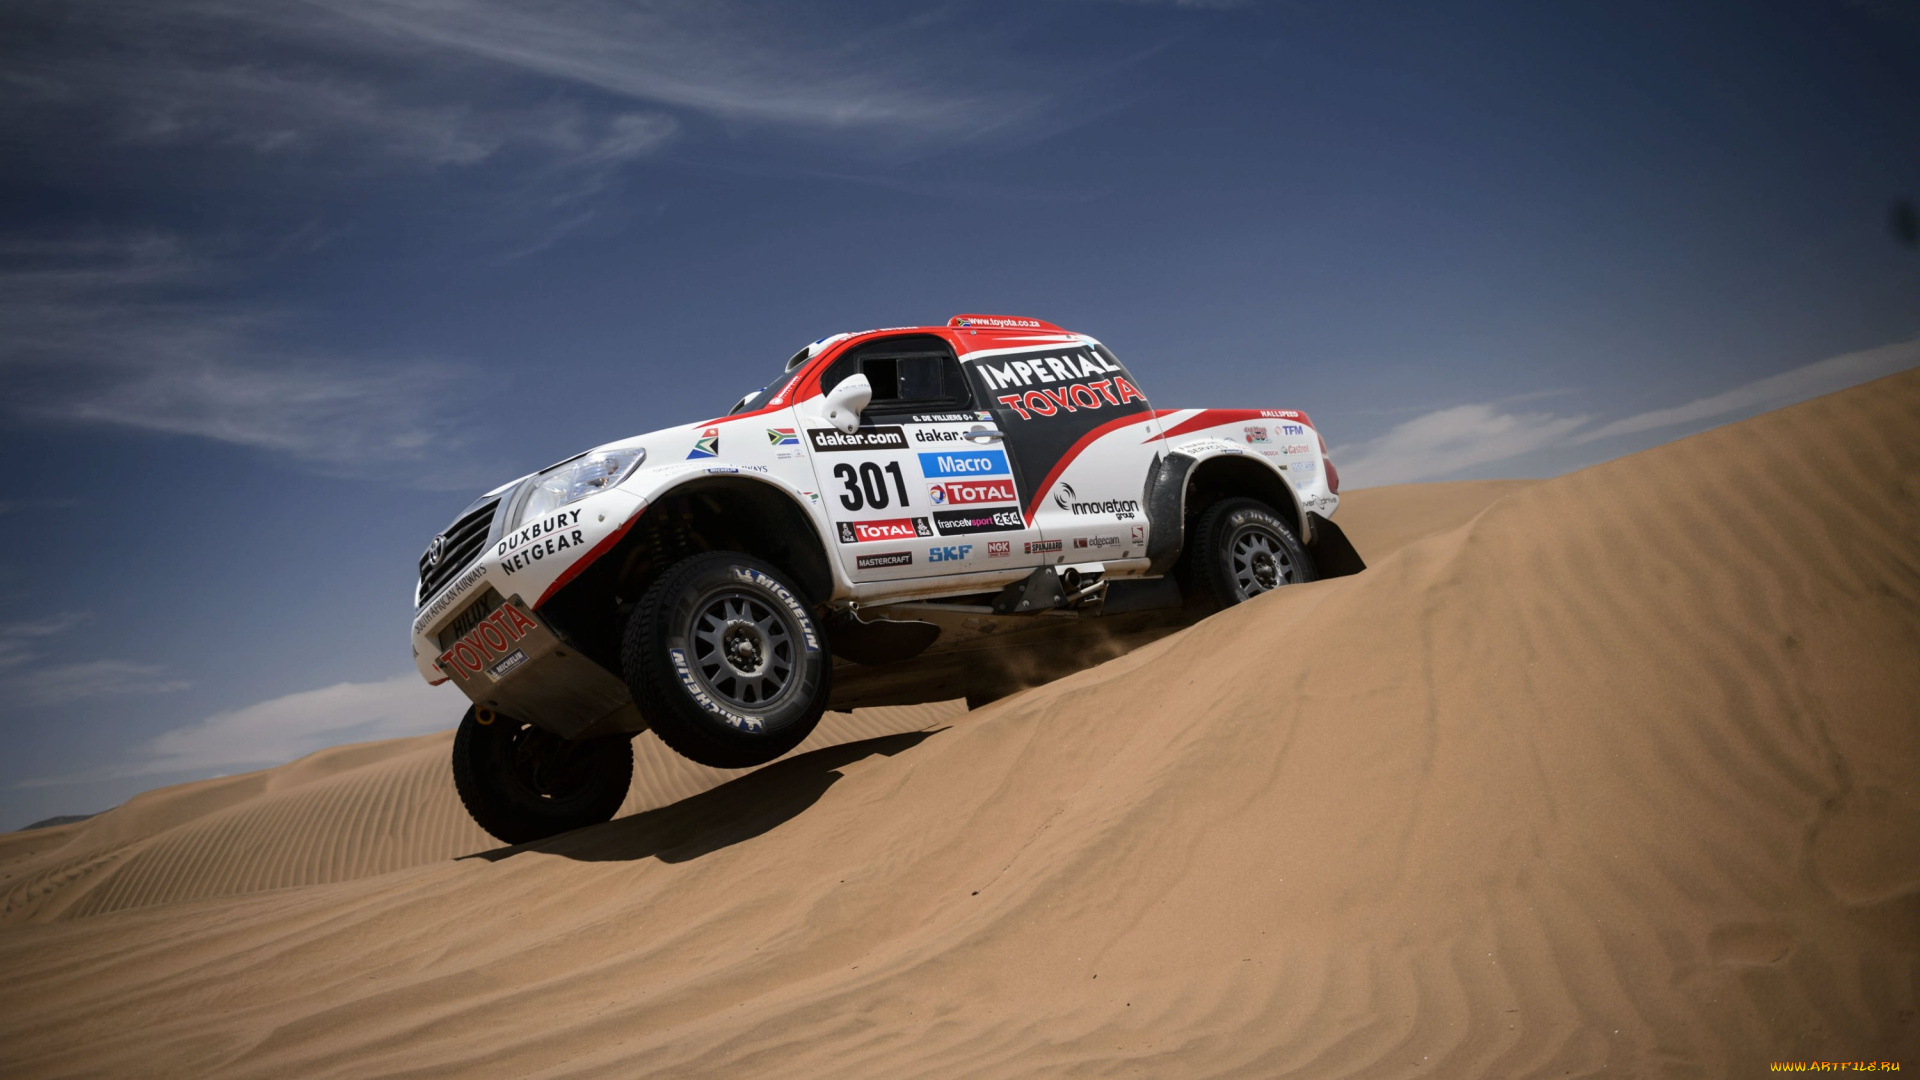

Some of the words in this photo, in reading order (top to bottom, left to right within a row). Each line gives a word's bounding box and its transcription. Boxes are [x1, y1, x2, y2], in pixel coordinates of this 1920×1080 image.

[968, 317, 1040, 328] www.toyota.co.za
[976, 351, 1121, 390] IMPERIAL
[997, 376, 1147, 420] TOYOTA
[932, 414, 961, 422] VILLIERS
[1260, 410, 1299, 418] HALLSPEED
[815, 431, 902, 446] dakar.com
[1282, 425, 1304, 435] TFM
[1287, 444, 1310, 454] Castrol
[937, 456, 992, 473] Macro
[833, 461, 910, 511] 301
[948, 484, 1014, 501] TOTAL
[1072, 499, 1140, 515] innovation
[1116, 512, 1135, 520] group
[498, 508, 582, 556] DUXBURY
[856, 524, 914, 538] TOTAL
[988, 542, 1009, 553] NGK
[1032, 541, 1063, 552] SPANJAARD
[1089, 536, 1120, 548] edgecam
[501, 529, 585, 576] NETGEAR
[928, 544, 973, 563] SKF
[859, 555, 911, 568] MASTERCRAFT
[415, 611, 433, 635] SOUTH
[431, 590, 457, 618] AFRICAN
[456, 562, 487, 595] AIRWAYS
[454, 595, 493, 638] HILUX
[755, 574, 819, 650] MICHELIN
[440, 601, 538, 681] TOYOTA
[496, 651, 524, 673] MICHELIN
[673, 651, 743, 728] MICHELIN
